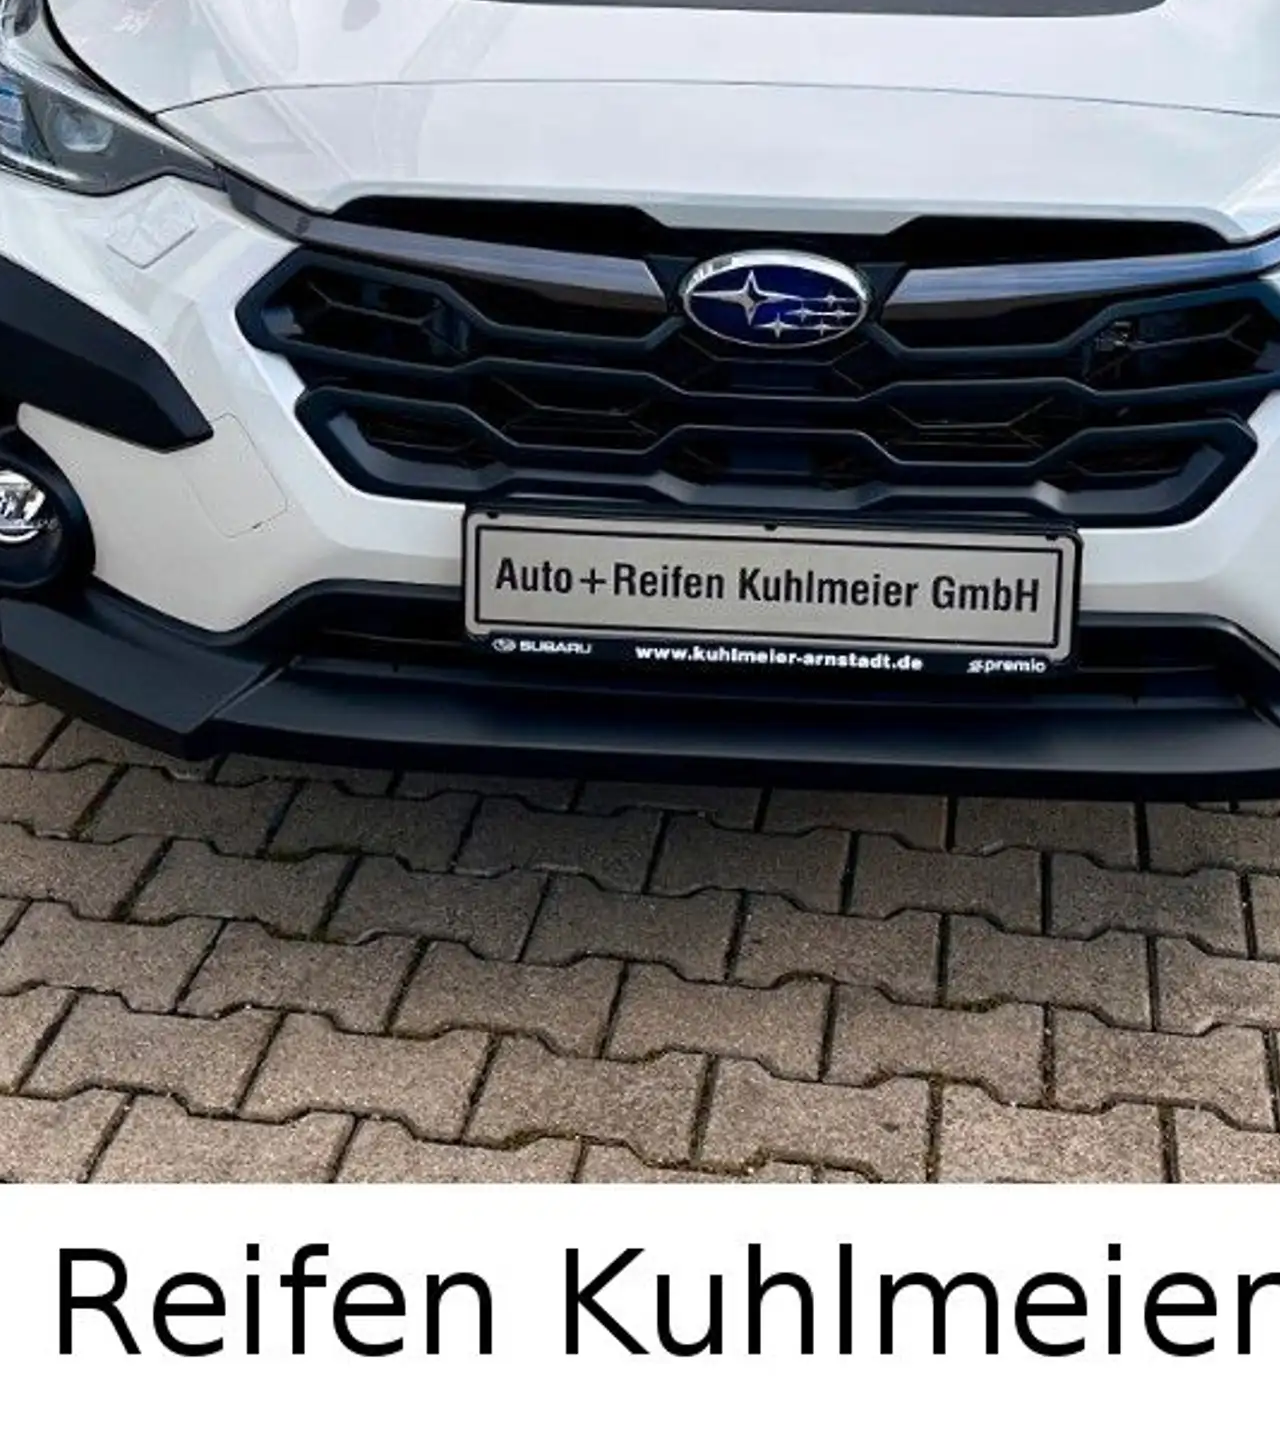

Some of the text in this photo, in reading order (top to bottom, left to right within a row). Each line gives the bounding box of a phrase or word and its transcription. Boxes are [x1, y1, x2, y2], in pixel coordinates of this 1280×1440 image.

[495, 557, 1039, 613] Auto + Reifen Kuhlmeier GmbH
[520, 640, 592, 654] SUBARU
[635, 645, 923, 671] www.kuhlmeier-arnstadt.de
[983, 659, 1046, 673] premio
